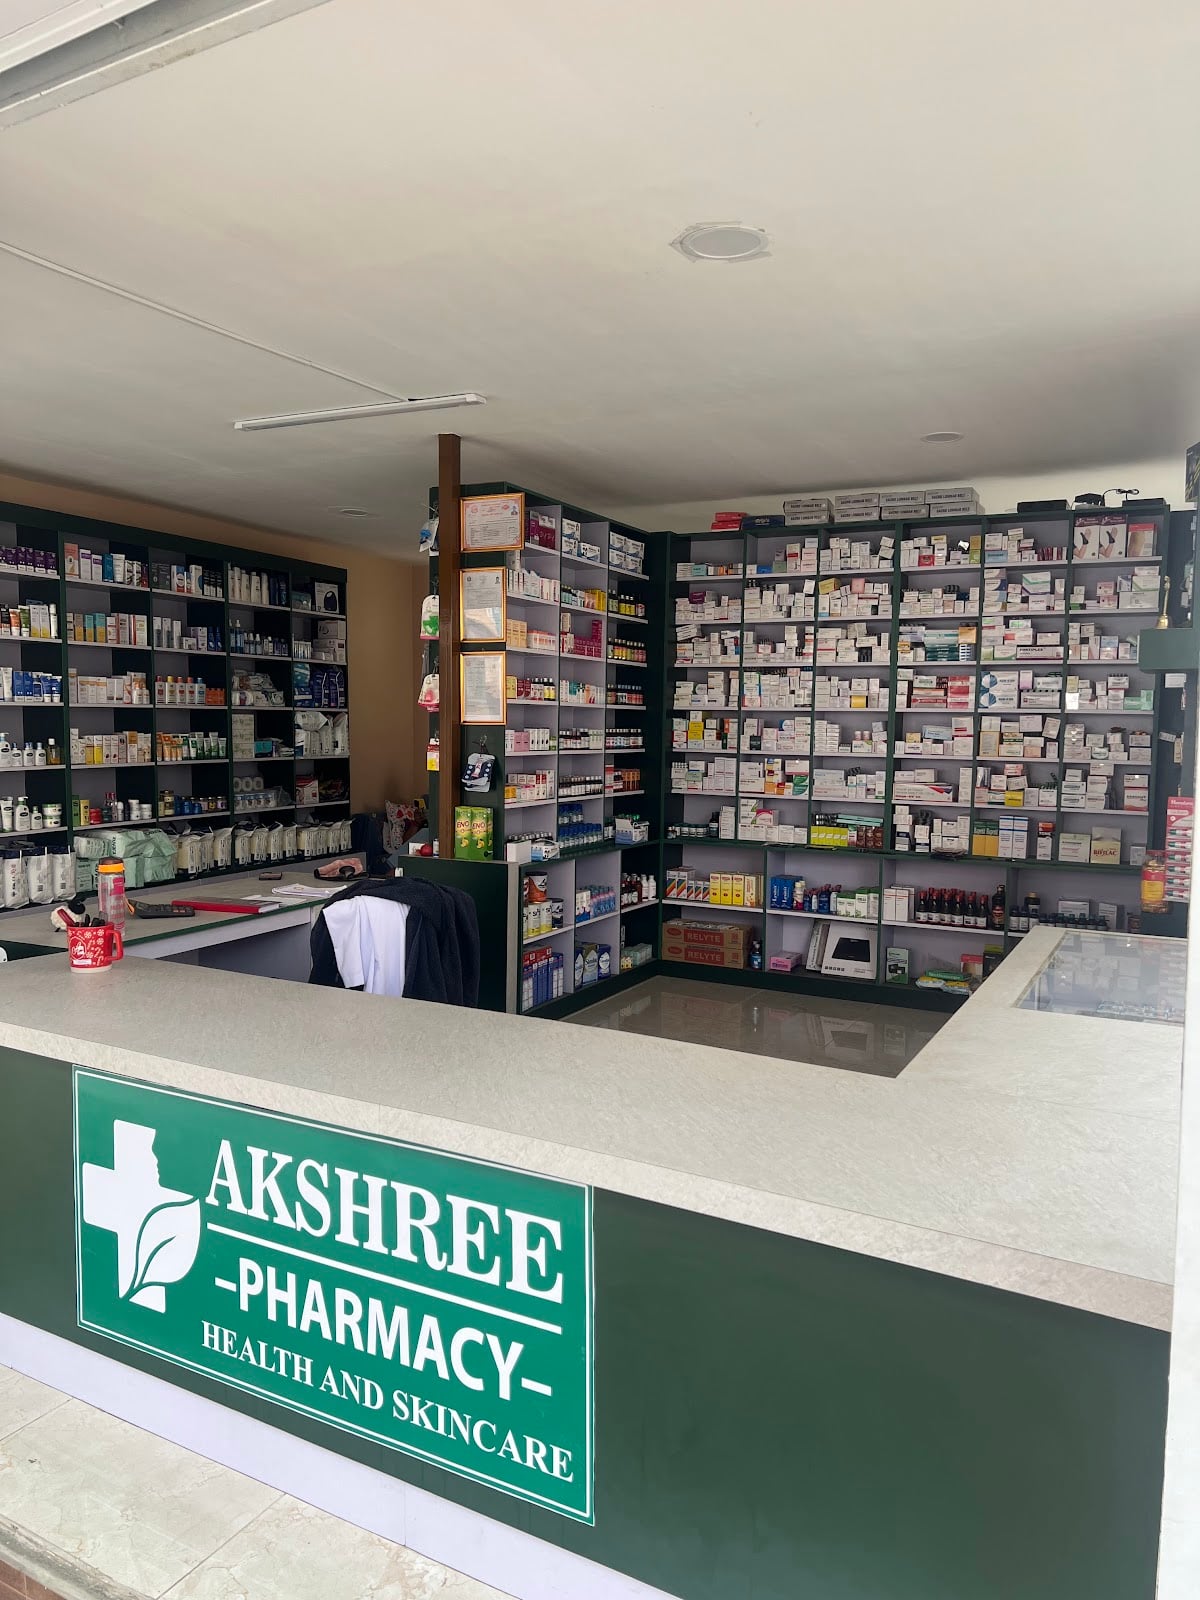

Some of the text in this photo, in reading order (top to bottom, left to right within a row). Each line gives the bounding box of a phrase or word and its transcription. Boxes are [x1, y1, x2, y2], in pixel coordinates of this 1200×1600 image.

[687, 933, 720, 942] RELYTE
[687, 951, 720, 960] RELYTE
[205, 1139, 563, 1304] AKSHREE
[202, 1321, 574, 1483] HEALTH AND SKINCARE
